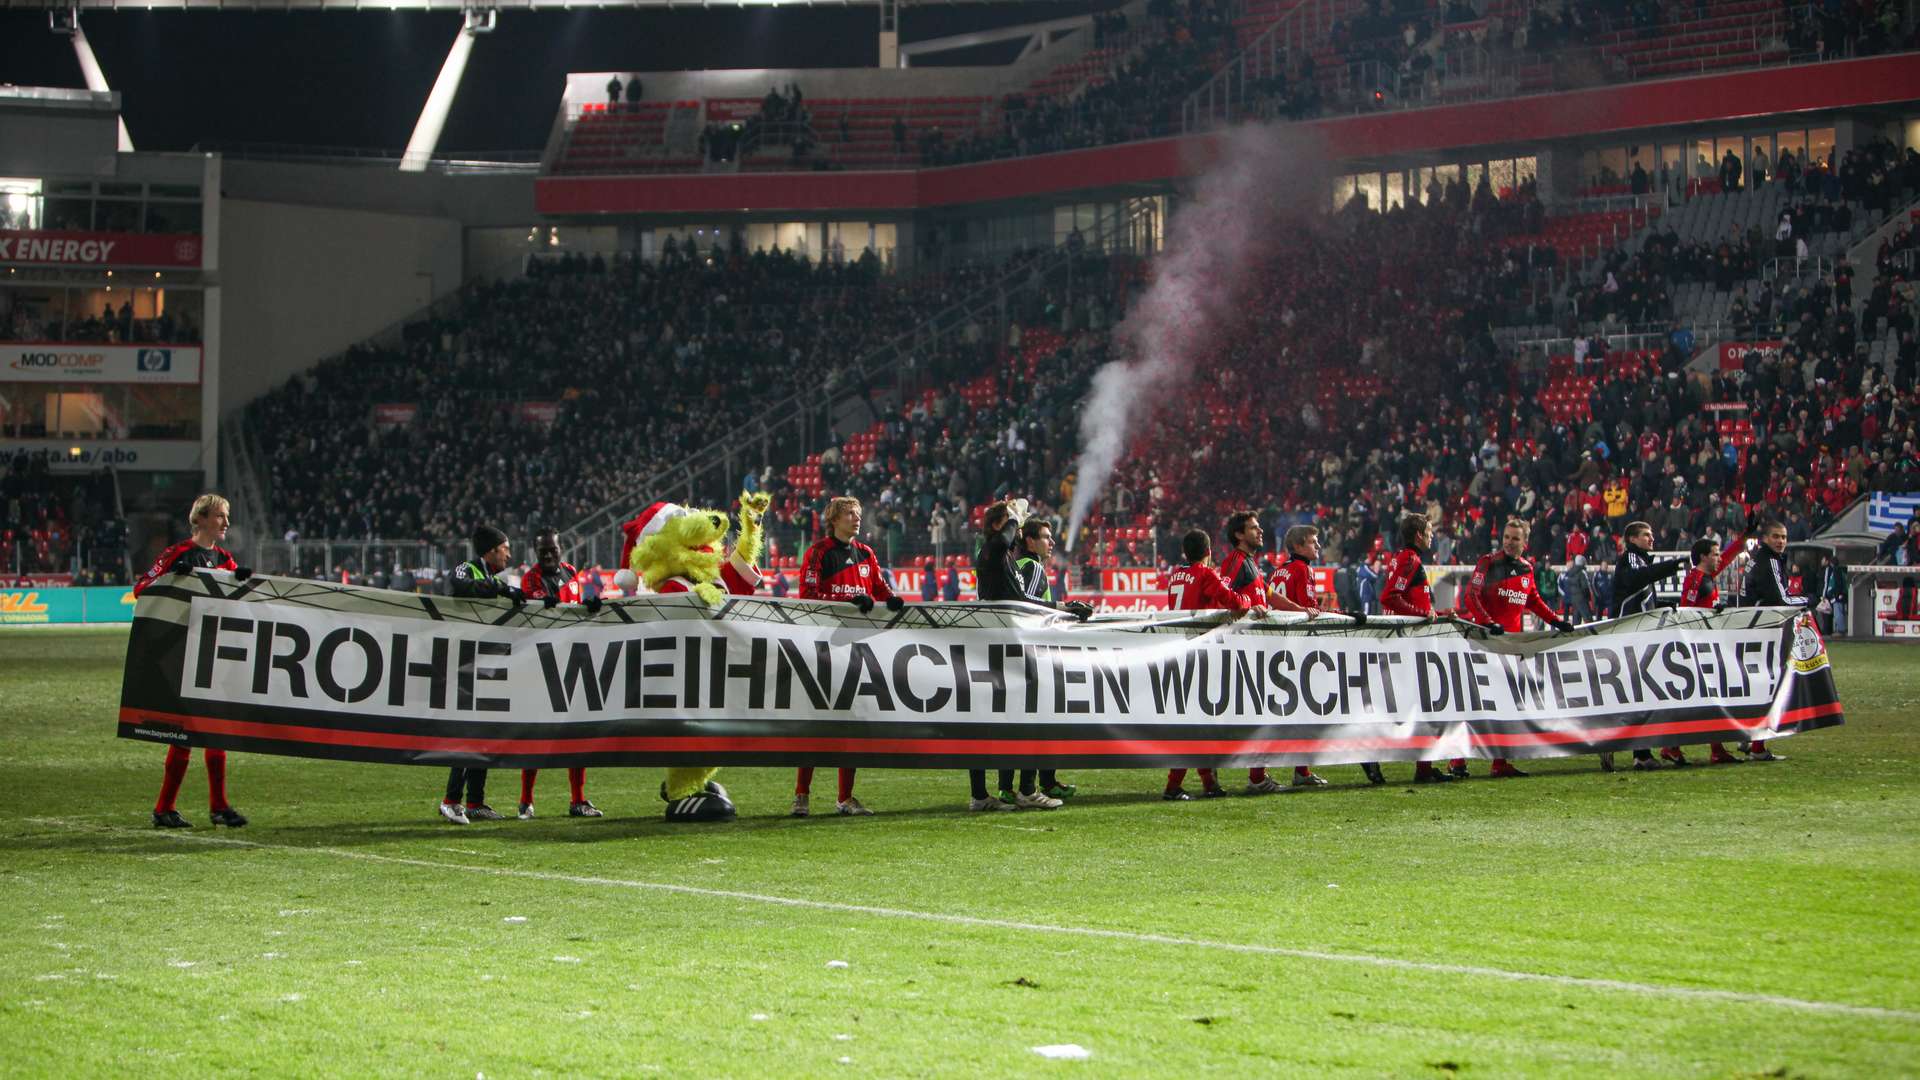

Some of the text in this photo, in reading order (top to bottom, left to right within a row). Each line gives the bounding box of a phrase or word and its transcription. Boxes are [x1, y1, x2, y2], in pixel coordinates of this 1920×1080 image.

[15, 238, 115, 263] ENERGY
[21, 353, 103, 367] MODCOMP
[1170, 584, 1184, 610] 7
[195, 614, 1776, 717] FROHE WEIHNACHTEN WÜNSCHT DIE WERKSELF!
[134, 727, 188, 740] www.bayer04.de
